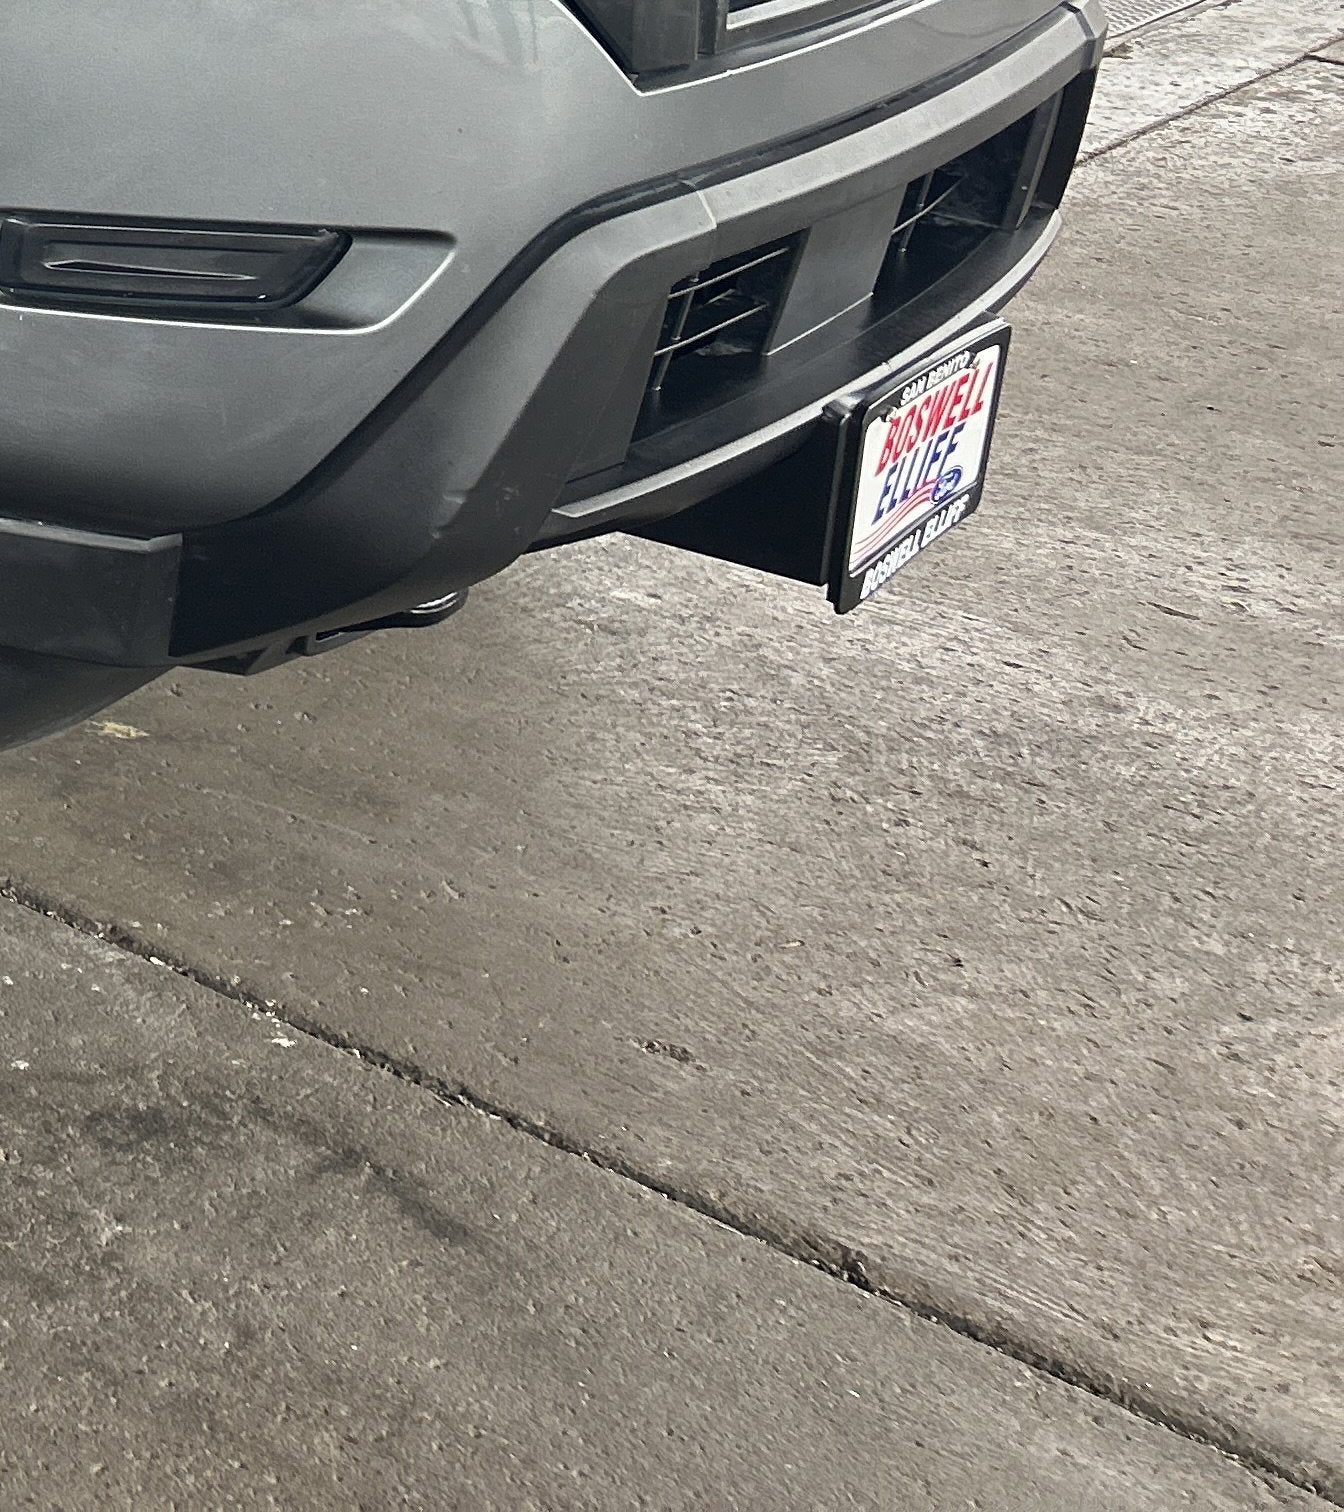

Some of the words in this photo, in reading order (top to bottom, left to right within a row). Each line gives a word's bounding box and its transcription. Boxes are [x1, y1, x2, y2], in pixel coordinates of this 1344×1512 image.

[874, 361, 993, 477] BOSWELL
[900, 375, 928, 406] SAN
[925, 350, 971, 390] BENITO
[871, 422, 966, 525] ELLIFF
[859, 528, 922, 600] BOSWELL
